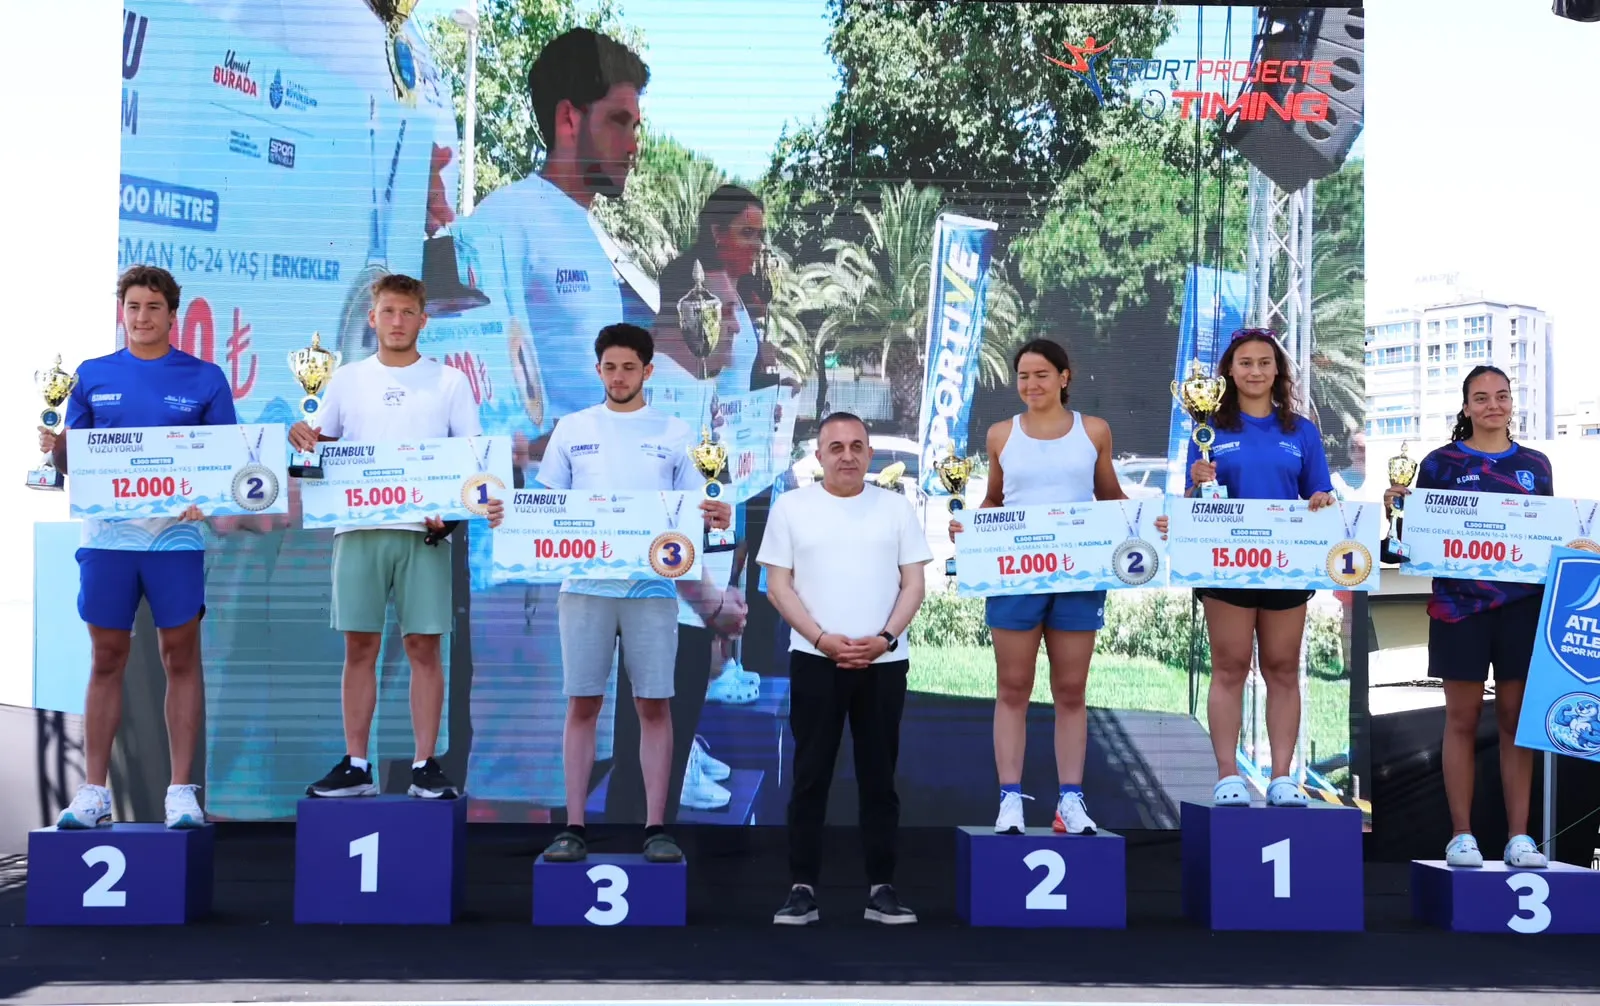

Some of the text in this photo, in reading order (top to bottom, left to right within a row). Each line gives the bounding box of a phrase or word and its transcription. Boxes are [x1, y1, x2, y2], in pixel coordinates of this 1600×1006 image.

[223, 49, 251, 75] Umut
[213, 65, 257, 98] BURADA
[1171, 90, 1329, 122] TIMING
[154, 189, 214, 223] METRE
[180, 246, 223, 272] 16-24
[228, 250, 258, 281] YAŞ
[272, 254, 340, 281] ERKEKLER
[87, 432, 143, 446] İSTANBUL'U
[321, 445, 375, 457] İSTANBUL'U
[112, 476, 193, 498] 12.000 ₺
[246, 478, 264, 499] 2
[345, 486, 424, 507] 15.000 ₺
[476, 483, 488, 504] 1
[513, 492, 567, 505] İSTANBUL'U
[1191, 501, 1245, 515] İSTANBUL'U
[1424, 493, 1480, 508] İSTANBUL'U
[973, 511, 1026, 525] İSTANBUL'U
[1407, 526, 1431, 534] YÜZME
[1432, 528, 1454, 536] GENEL
[1528, 534, 1563, 542] KADINLAR
[534, 538, 613, 559] 10.000 ₺
[662, 542, 682, 567] 3
[1211, 547, 1289, 569] 15.000 ₺
[1443, 538, 1523, 562] 10.000 ₺
[997, 552, 1075, 575] 12.000 ₺
[1126, 551, 1145, 573] 2
[1342, 551, 1356, 575] 1
[1560, 644, 1586, 656] SPOR
[349, 831, 379, 892] 1
[1261, 837, 1291, 898] 1
[81, 845, 127, 907] 2
[1022, 849, 1067, 910] 2
[584, 864, 629, 926] 3
[1505, 872, 1552, 934] 3
